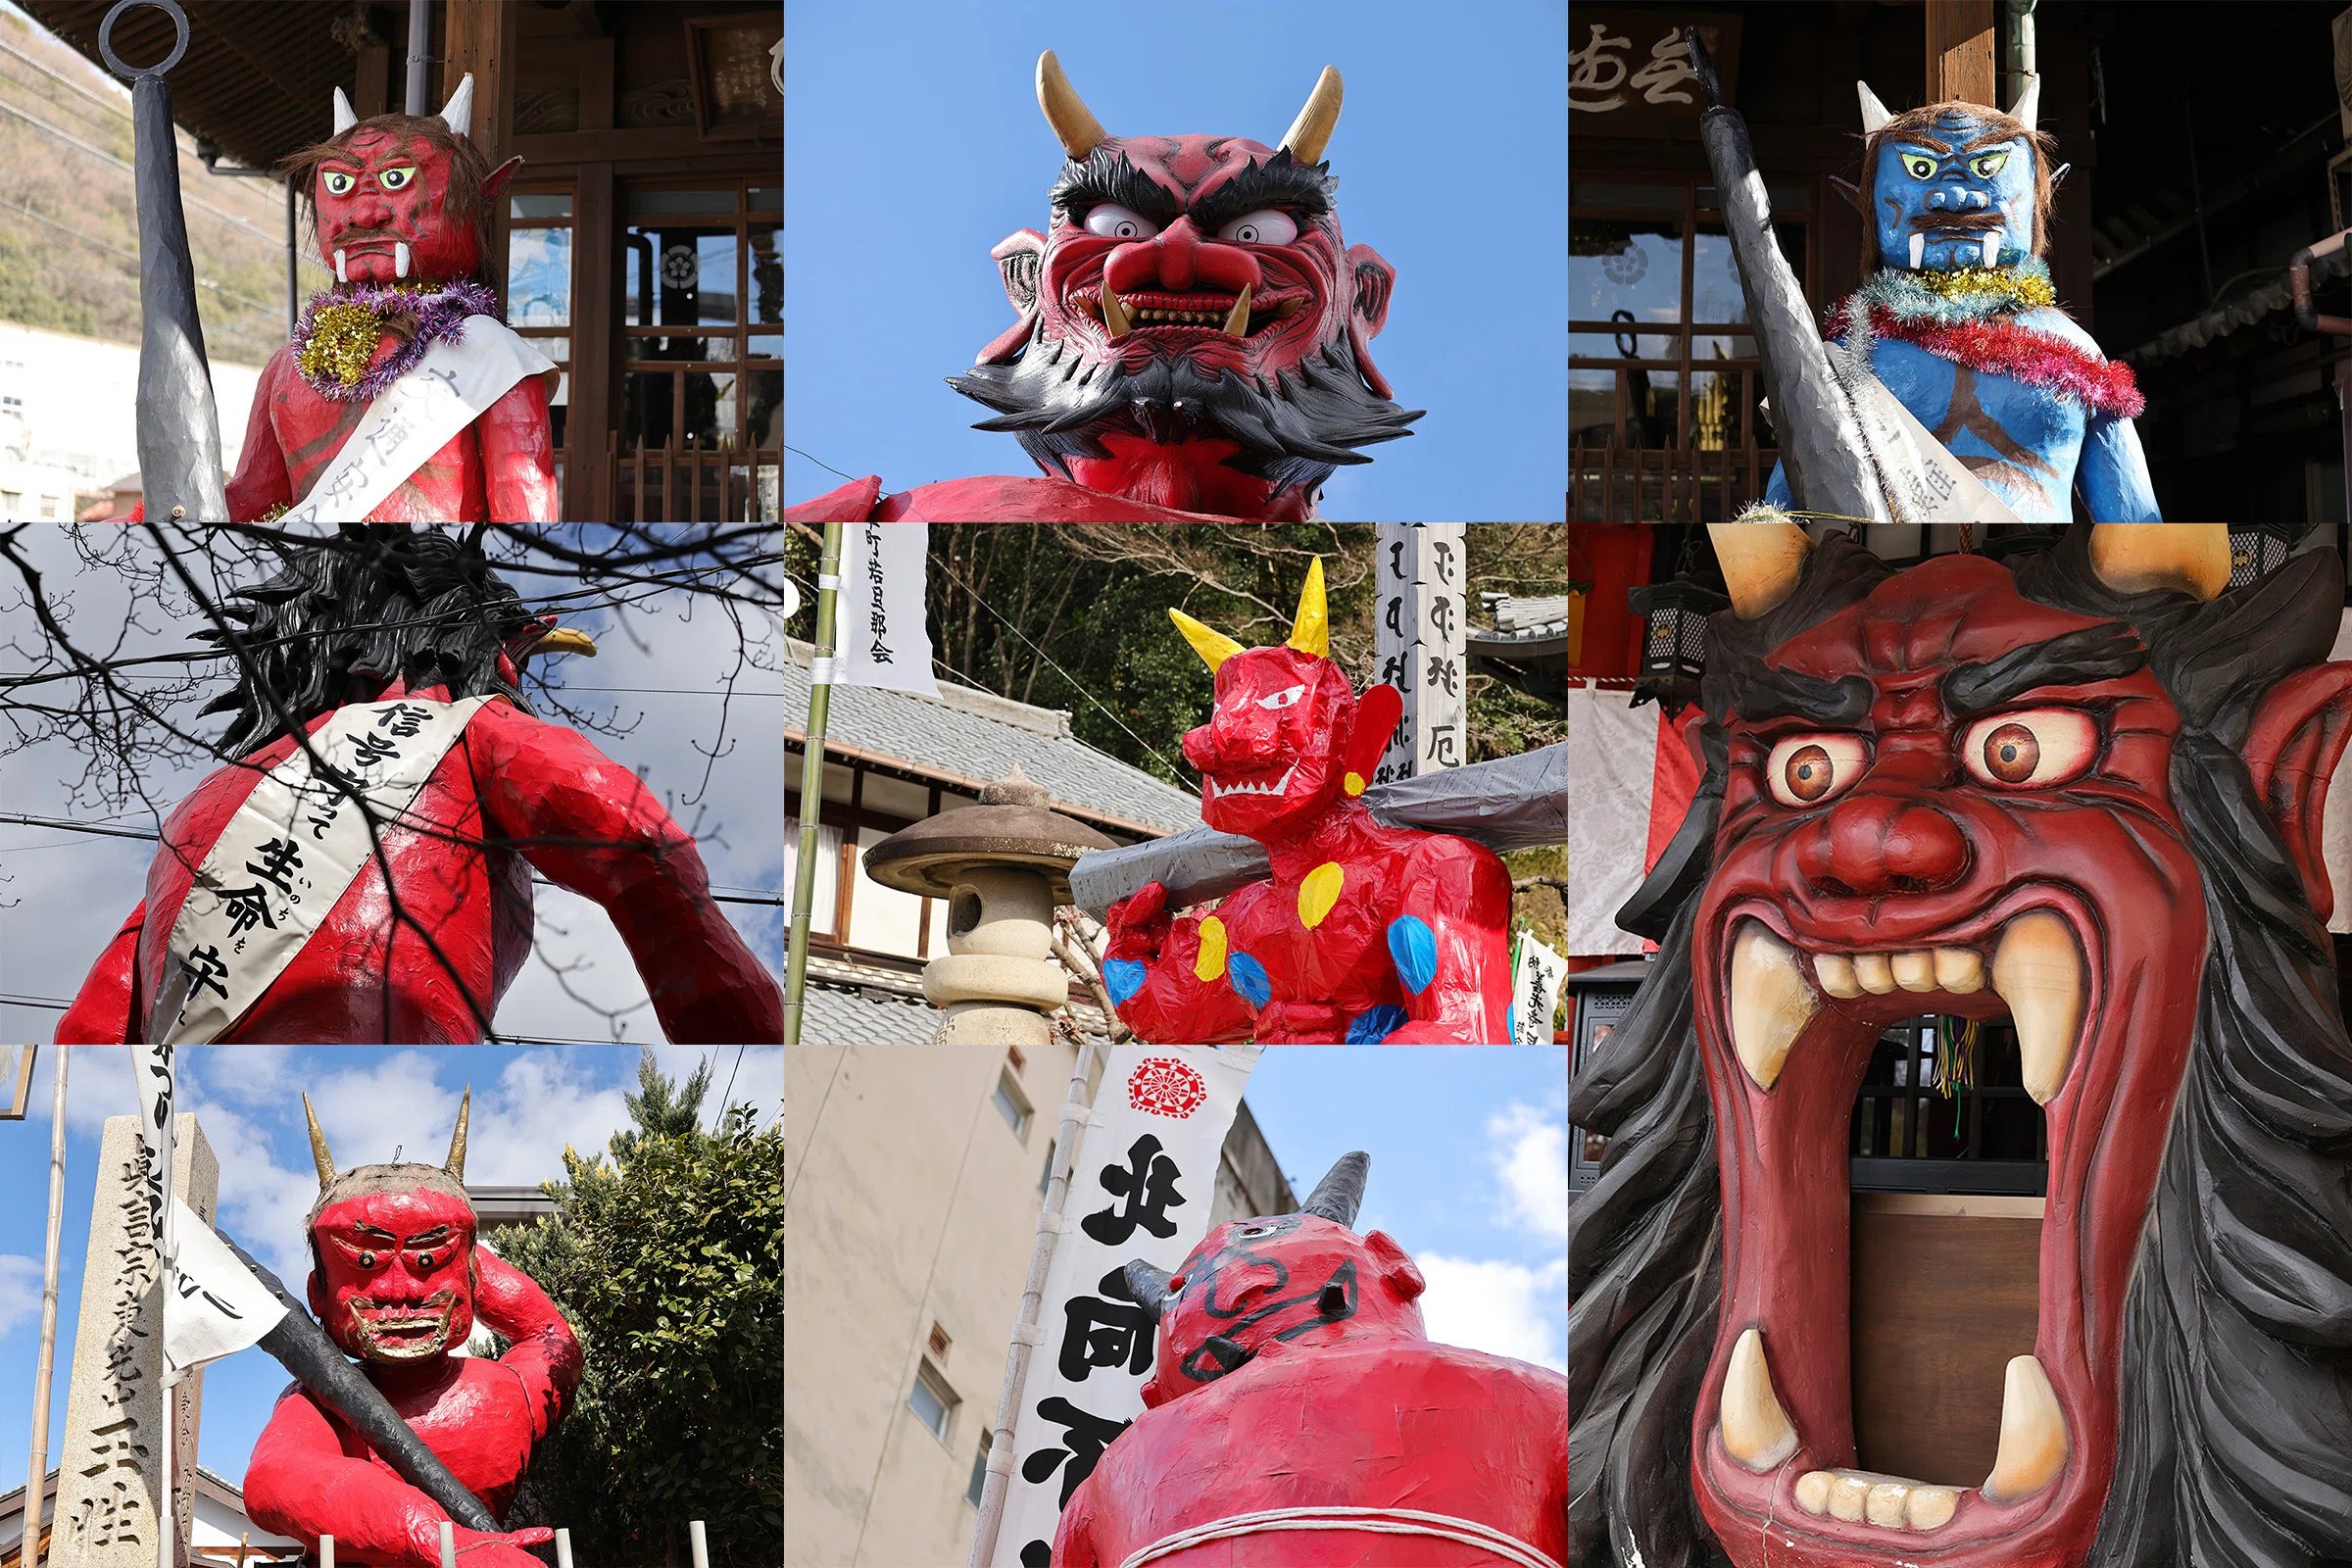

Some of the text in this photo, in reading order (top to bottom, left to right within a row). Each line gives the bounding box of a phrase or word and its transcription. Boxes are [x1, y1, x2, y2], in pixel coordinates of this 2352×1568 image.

[865, 522, 894, 664] 町若旦那会
